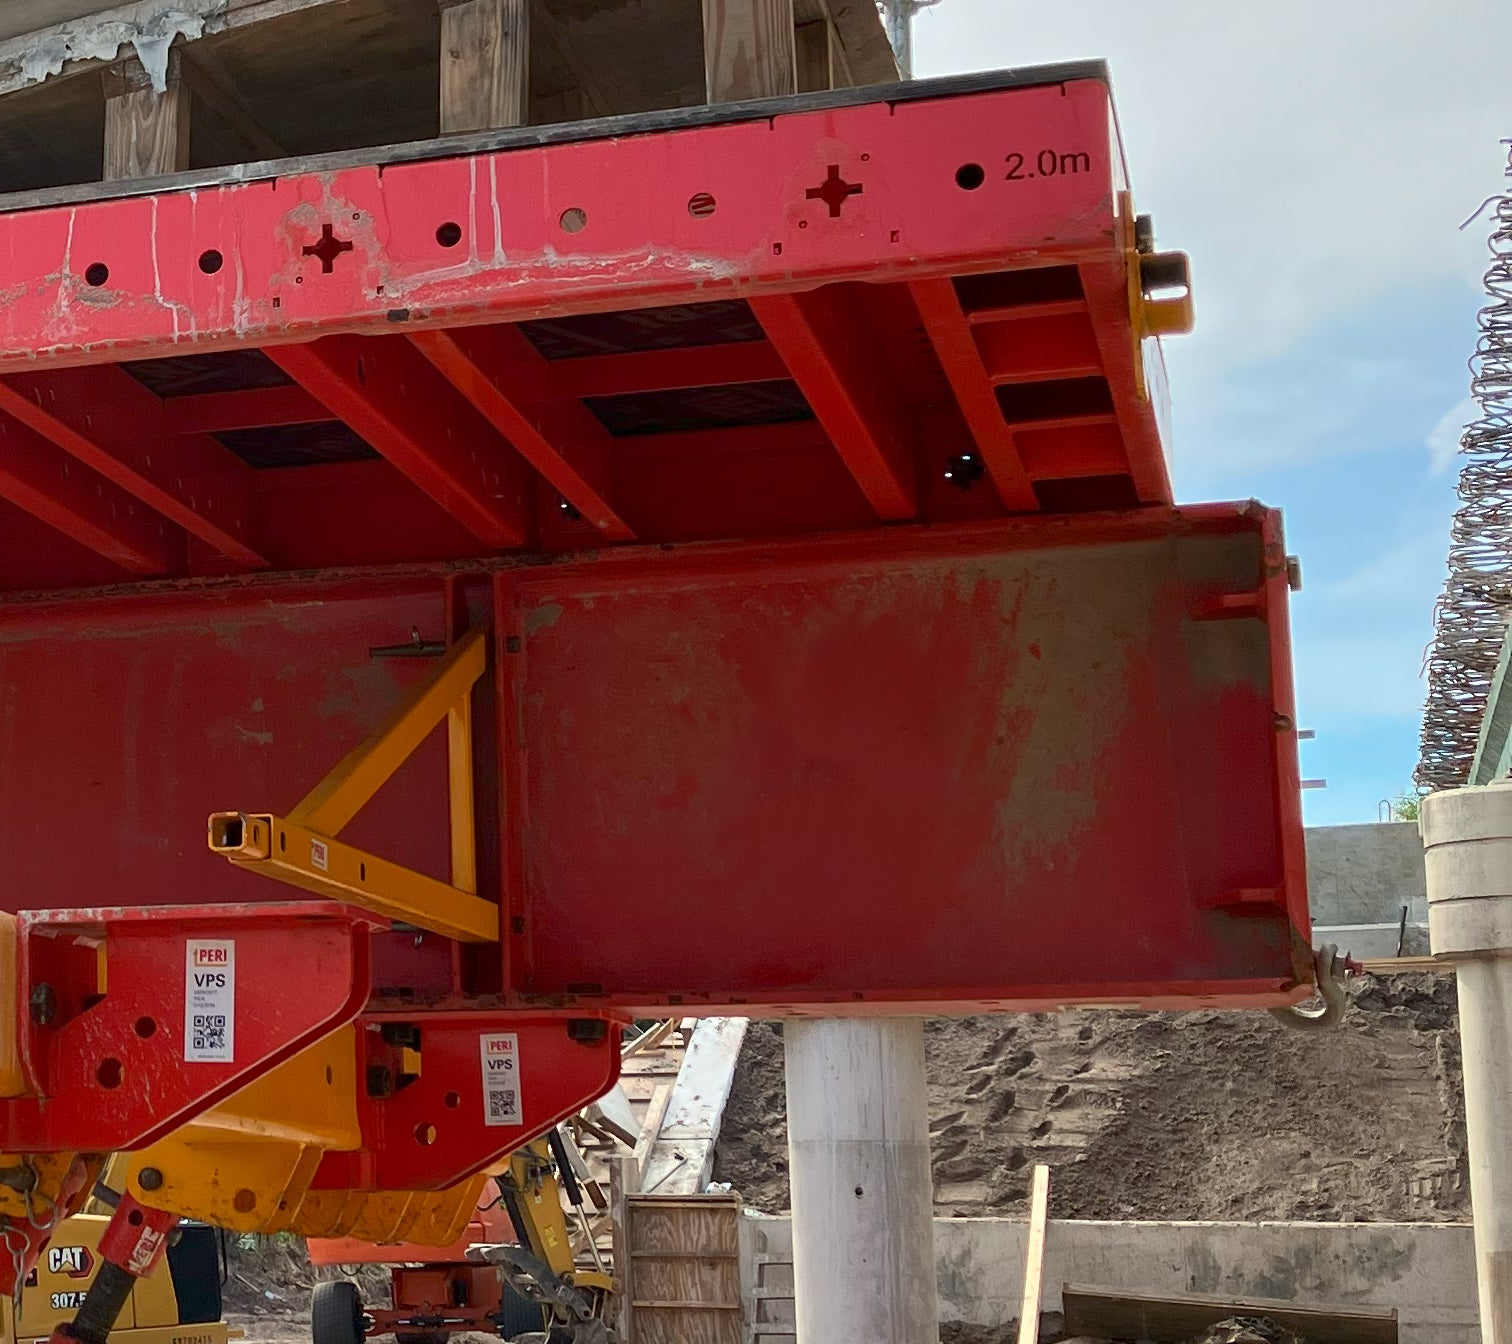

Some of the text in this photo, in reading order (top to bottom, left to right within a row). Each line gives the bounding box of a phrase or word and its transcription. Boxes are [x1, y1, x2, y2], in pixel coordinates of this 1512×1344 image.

[1004, 149, 1090, 181] 2.0m
[199, 948, 227, 962] PERI
[194, 973, 226, 988] VPS
[490, 1040, 513, 1051] PERI
[488, 1058, 513, 1070] VPS
[48, 1247, 83, 1272] CAT
